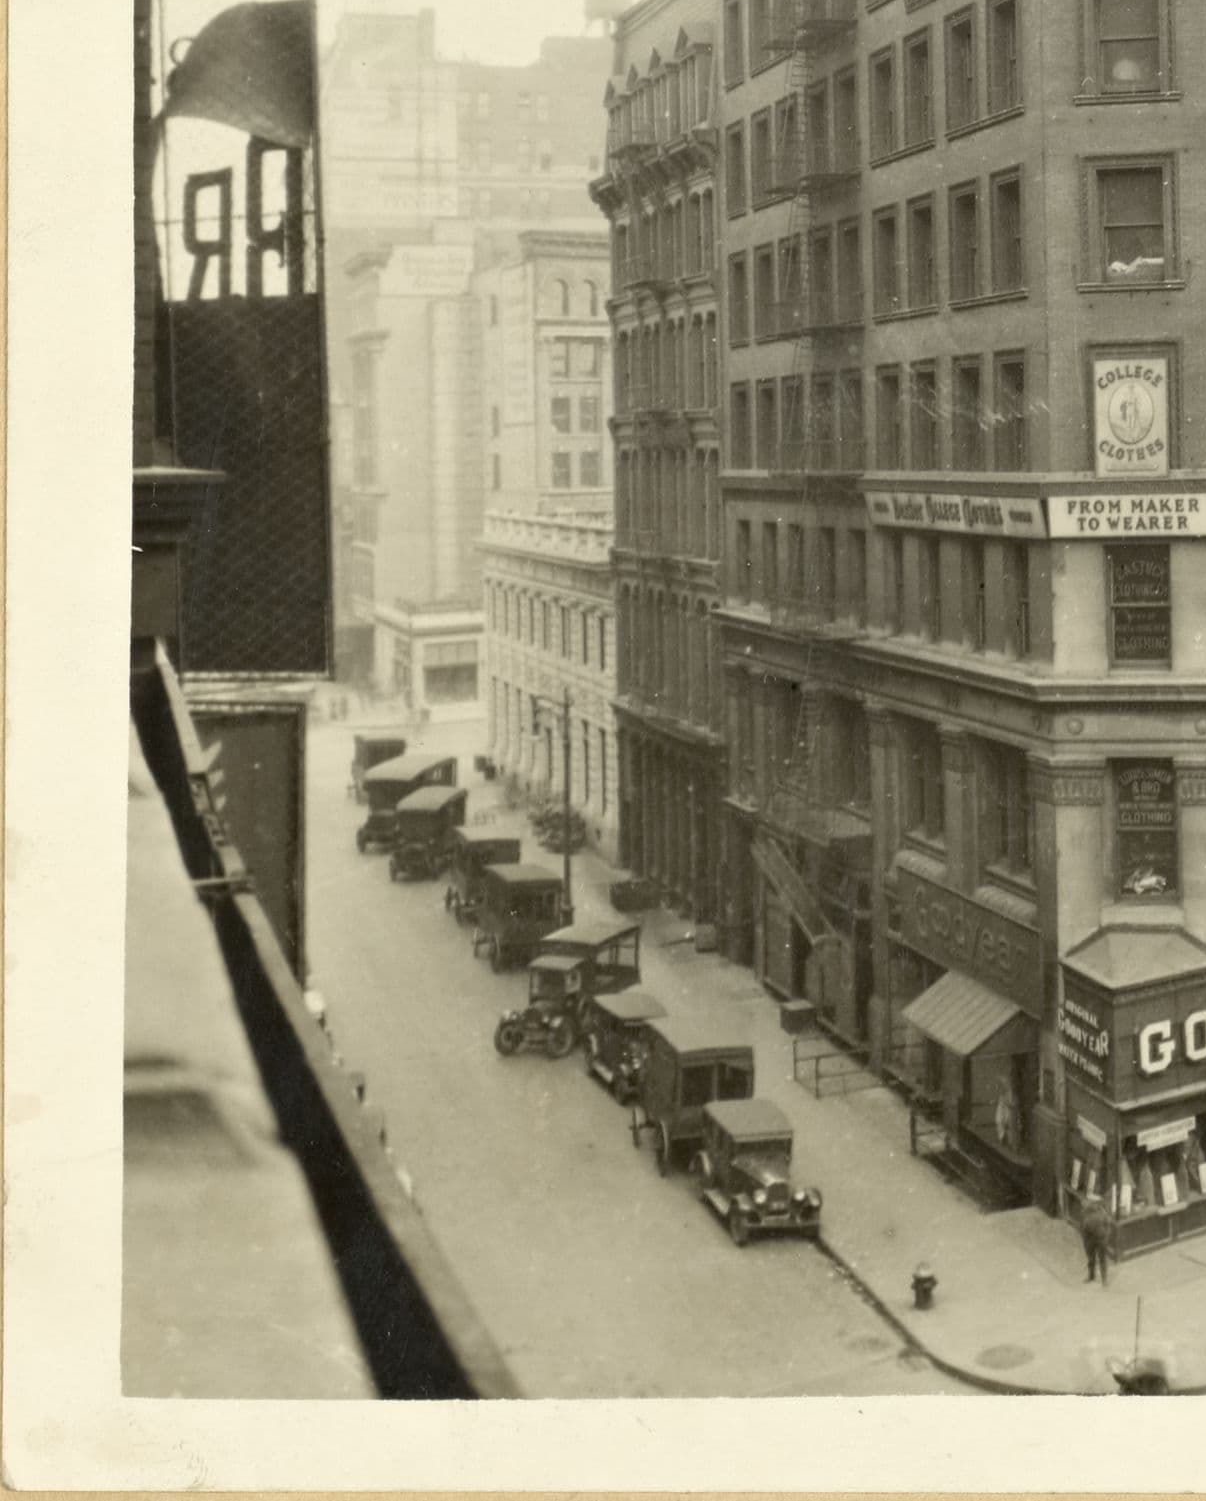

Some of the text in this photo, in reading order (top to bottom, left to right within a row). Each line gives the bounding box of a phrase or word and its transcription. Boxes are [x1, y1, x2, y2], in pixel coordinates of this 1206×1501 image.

[1097, 365, 1163, 390] COLLEGE
[1099, 438, 1165, 463] CLOTHES
[1067, 498, 1201, 515] FROM MAKER
[1077, 515, 1189, 532] TO WEARER
[1121, 810, 1173, 824] CLOTHING
